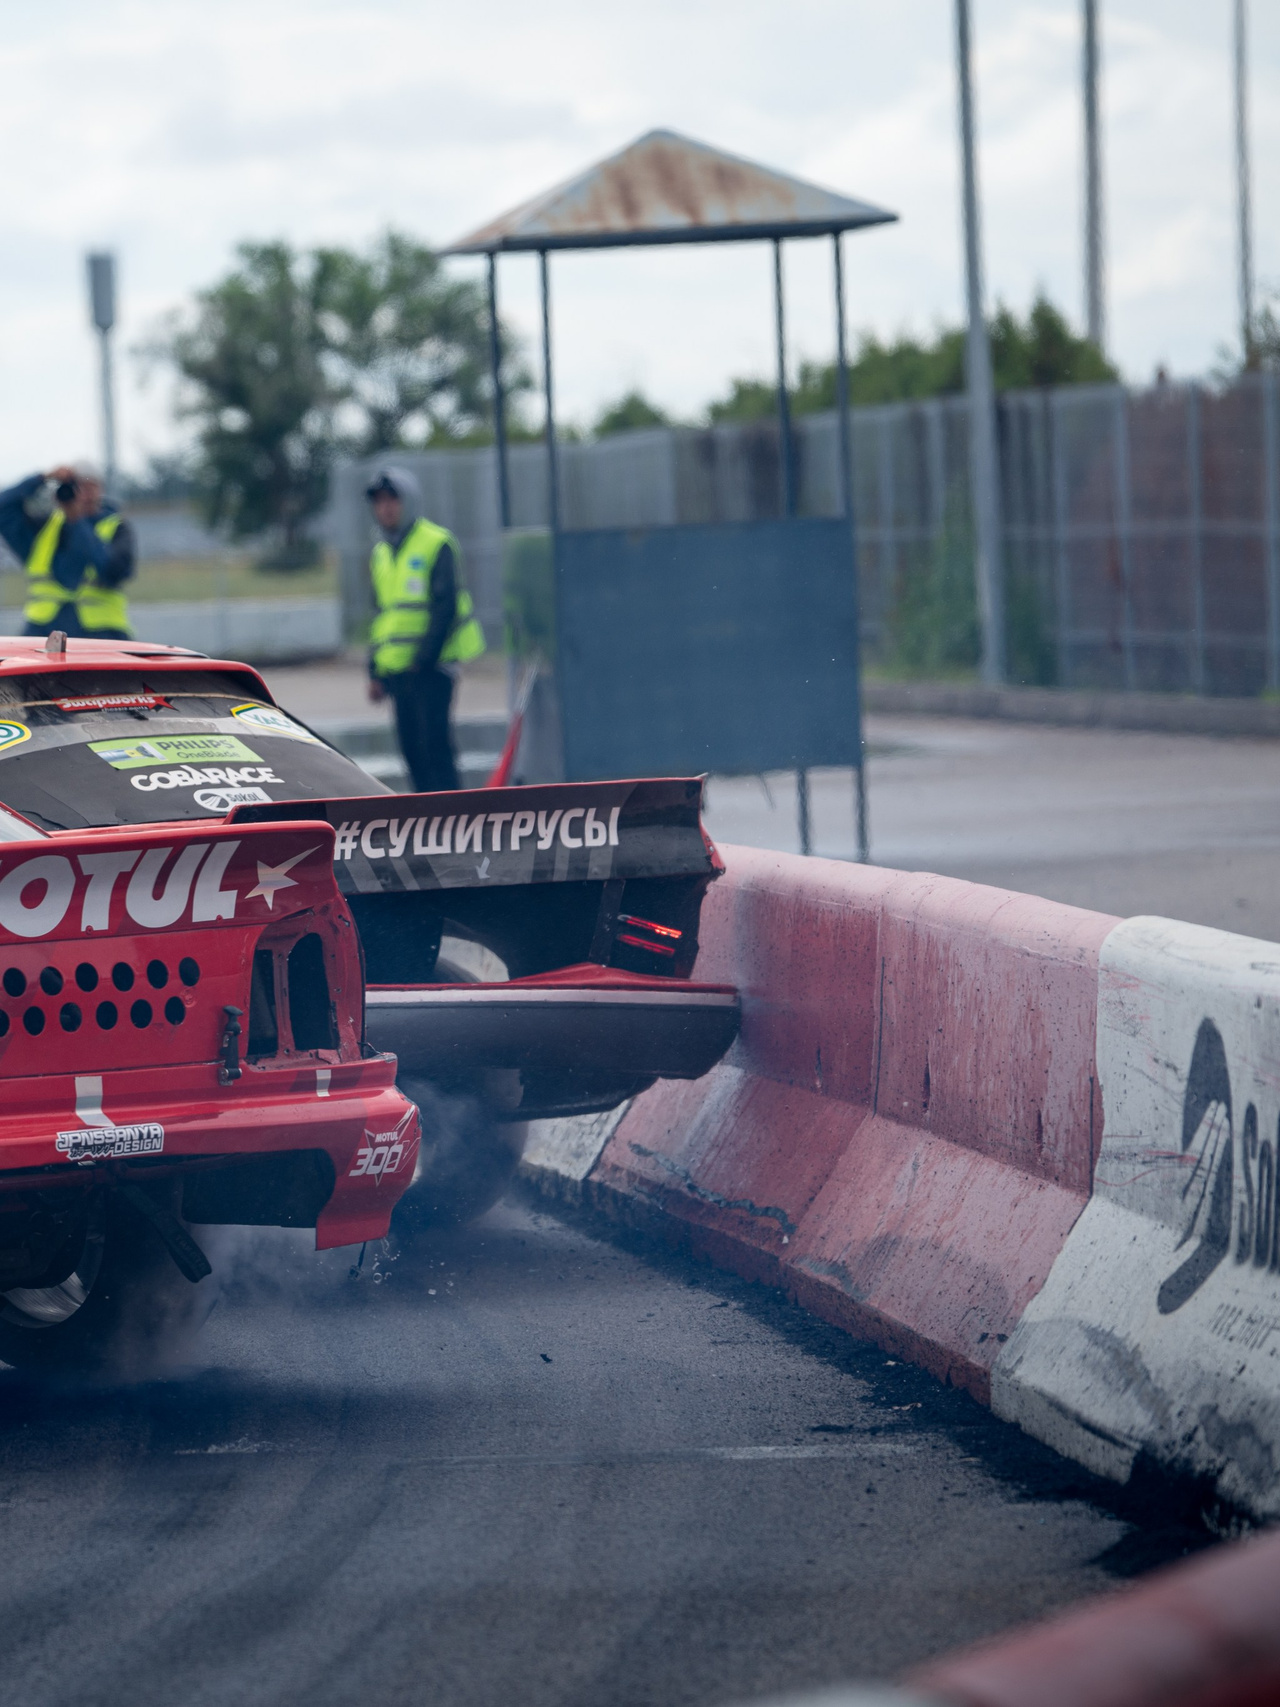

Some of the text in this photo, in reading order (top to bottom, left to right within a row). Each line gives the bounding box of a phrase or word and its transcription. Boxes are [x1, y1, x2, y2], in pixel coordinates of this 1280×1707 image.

[155, 739, 234, 751] PHILIPS
[177, 750, 241, 759] OneBlade
[334, 807, 620, 860] #СУШИТРУСЫ
[375, 1131, 399, 1143] MOTUL
[114, 1138, 161, 1154] DESIGN
